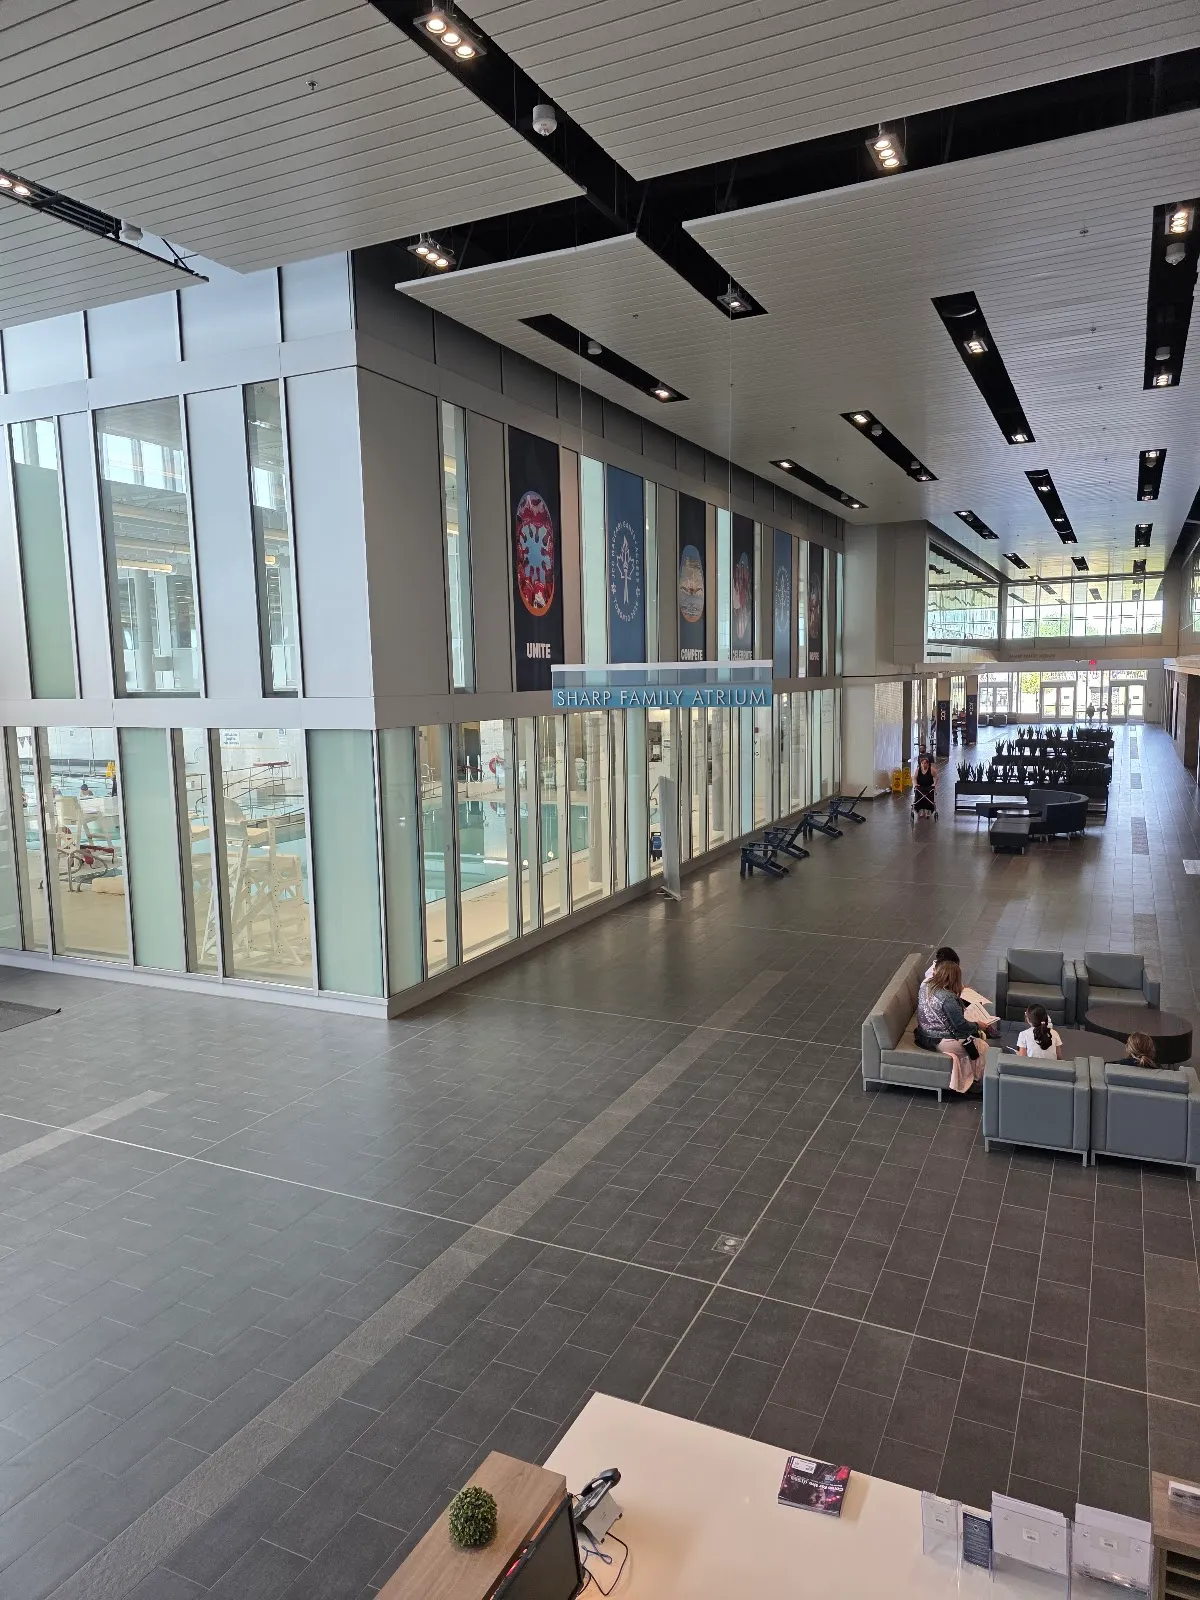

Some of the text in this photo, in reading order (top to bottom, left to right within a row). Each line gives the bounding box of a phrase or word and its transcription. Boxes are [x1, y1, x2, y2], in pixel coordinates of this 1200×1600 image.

[526, 642, 552, 659] UNITE
[680, 648, 703, 661] COMPETE
[557, 688, 766, 706] SHARP FAMILY ATRIUM
